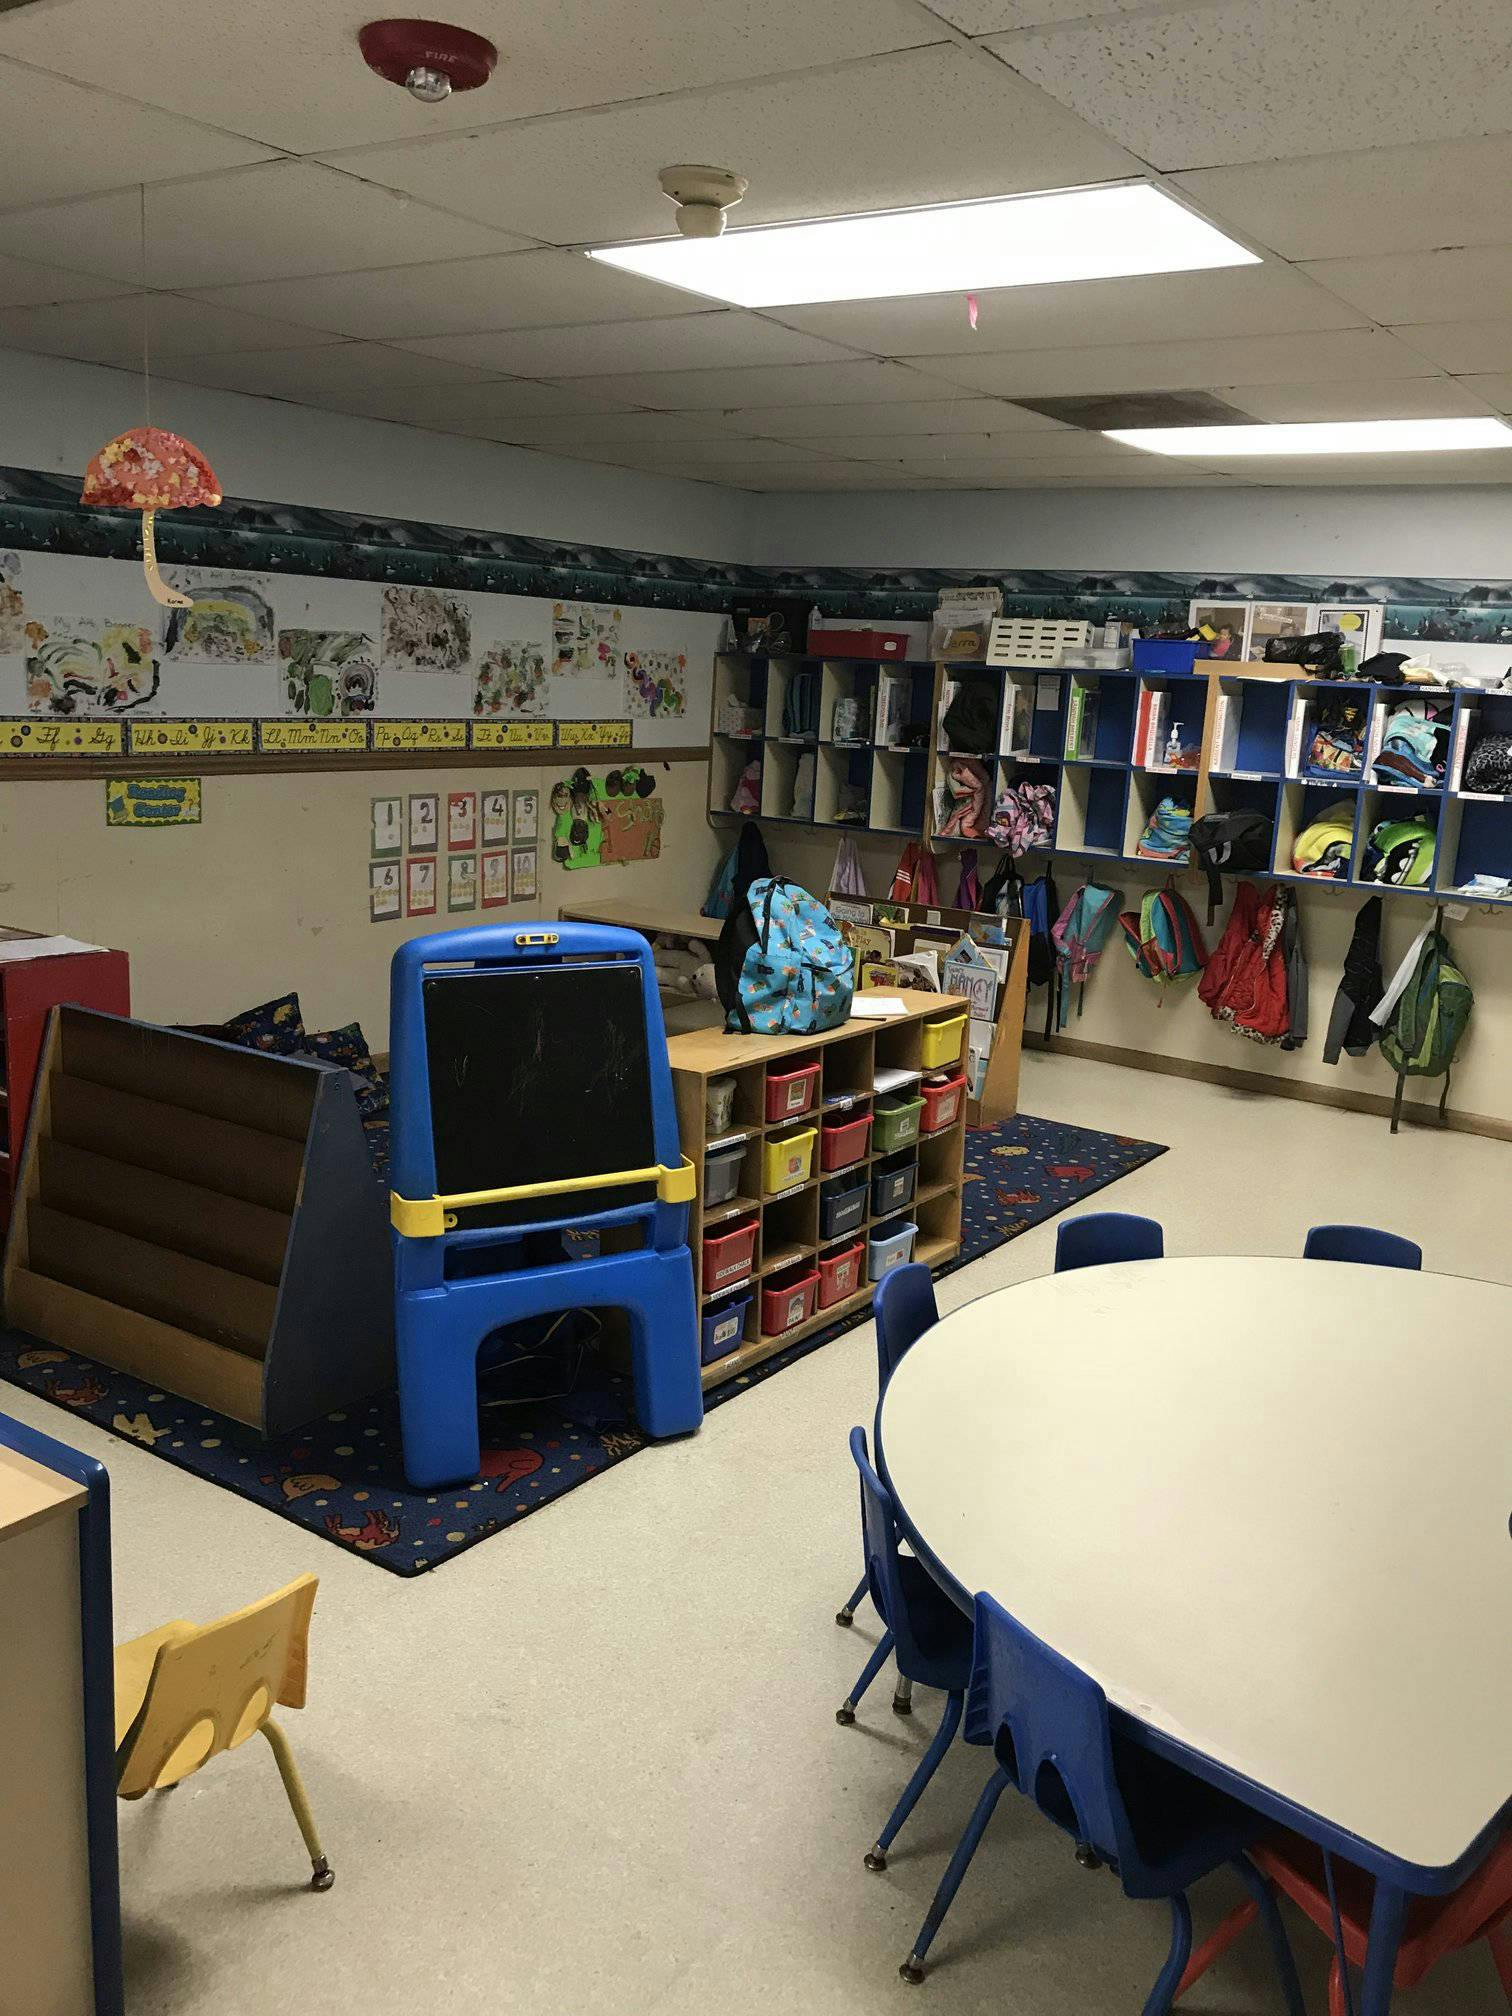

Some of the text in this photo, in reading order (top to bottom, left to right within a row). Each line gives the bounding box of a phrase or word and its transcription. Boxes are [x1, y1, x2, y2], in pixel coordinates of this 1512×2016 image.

[424, 50, 459, 64] FIRE
[387, 802, 393, 826] 1
[419, 801, 433, 824] 2
[458, 799, 468, 818] 3
[491, 798, 504, 817] 4
[523, 796, 534, 815] 5
[419, 864, 430, 883] 7
[460, 861, 469, 880] 8
[489, 858, 499, 878] 9
[516, 855, 532, 874] 10
[383, 867, 394, 886] 6
